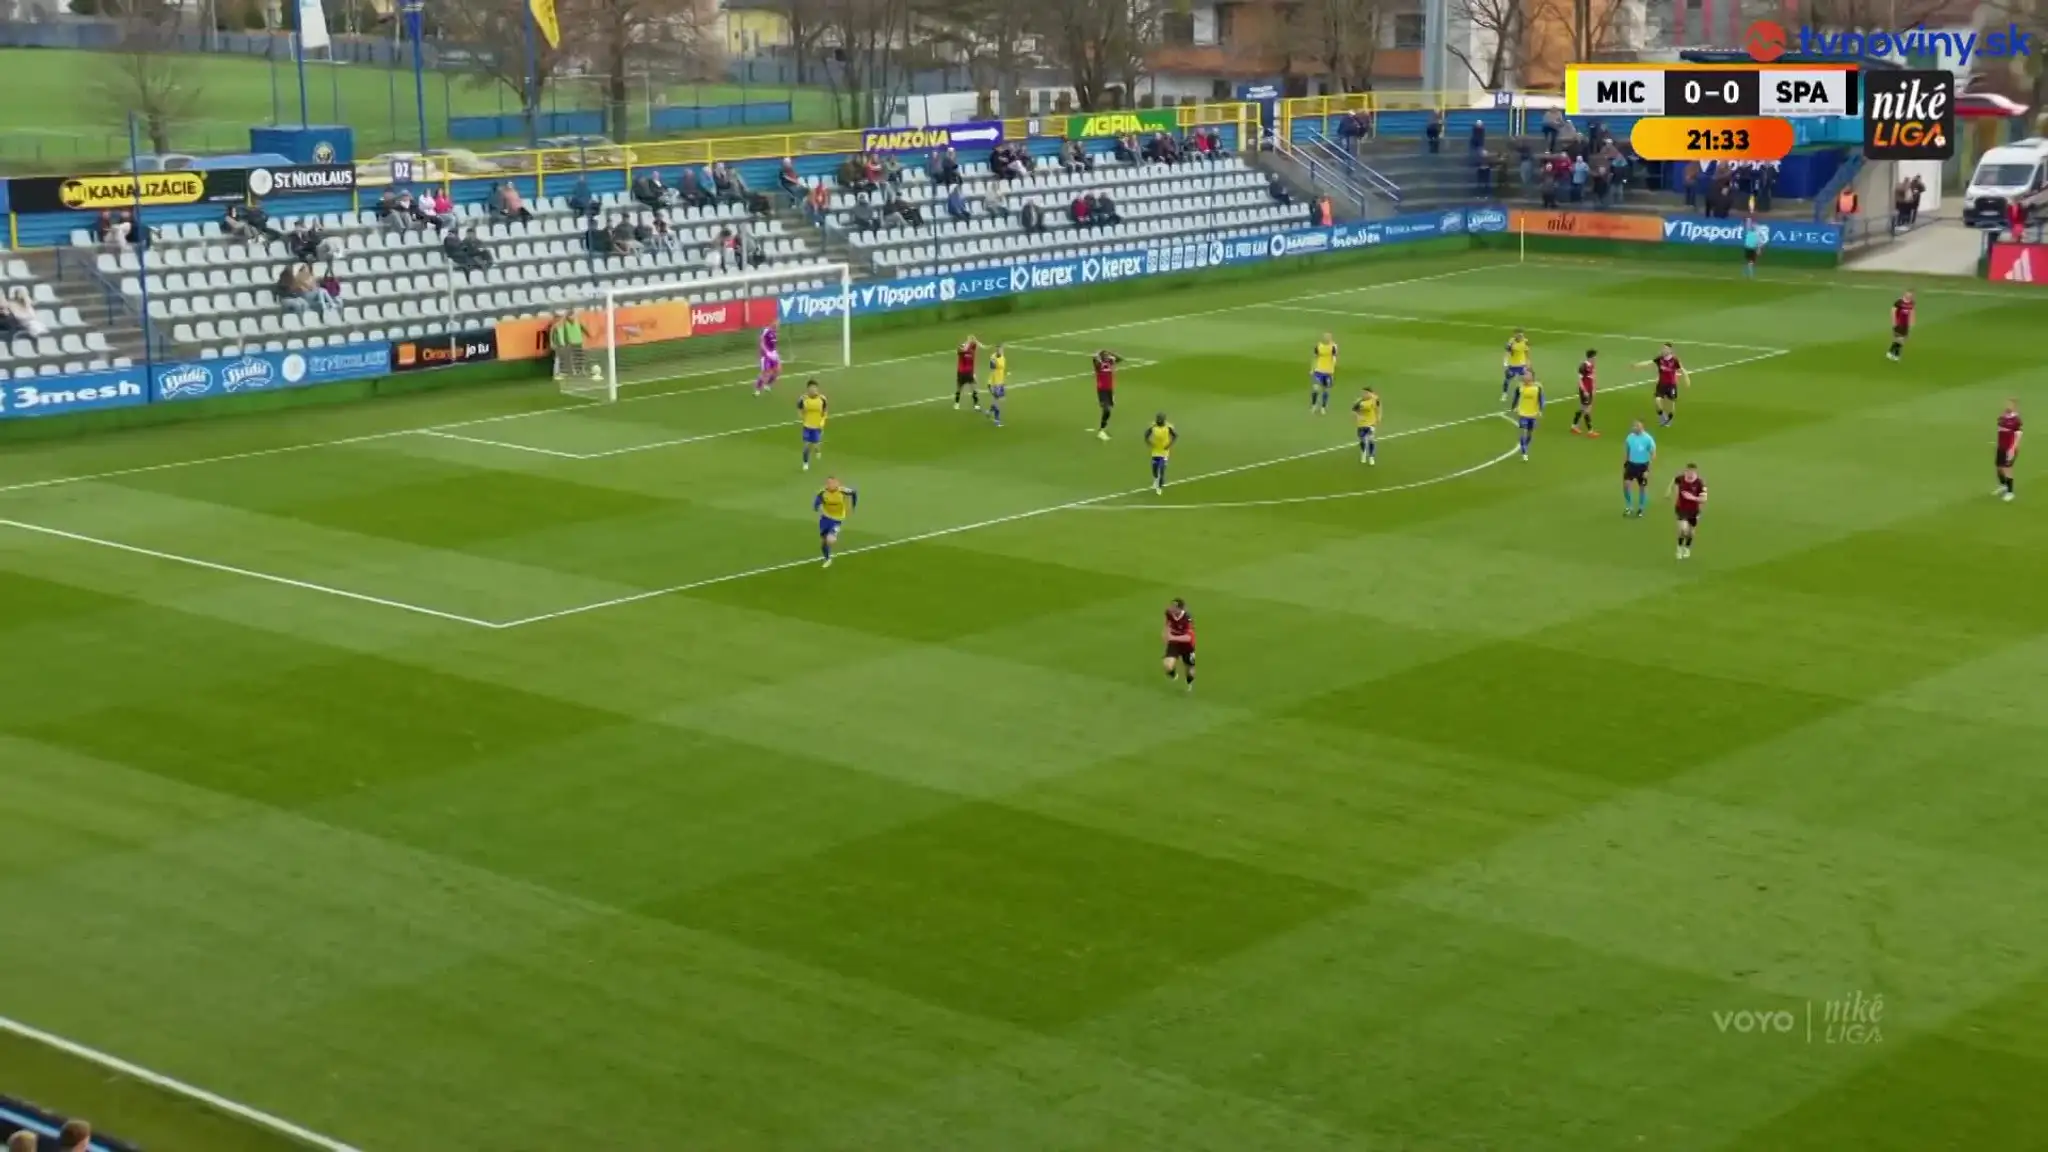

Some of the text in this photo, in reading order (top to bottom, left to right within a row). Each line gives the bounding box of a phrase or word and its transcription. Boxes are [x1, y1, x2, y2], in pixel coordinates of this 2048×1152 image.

[1080, 115, 1144, 137] AGRIA
[395, 162, 409, 177] D2
[1681, 222, 1743, 242] Tipsport
[1771, 230, 1835, 244] APEC
[1032, 264, 1073, 288] kerex
[1102, 255, 1142, 279] kerex
[877, 282, 936, 307] Tipsport
[958, 276, 1008, 294] APEC
[797, 290, 857, 317] Tipspot
[691, 308, 726, 327] Hoval
[14, 380, 141, 408] 3mesh
